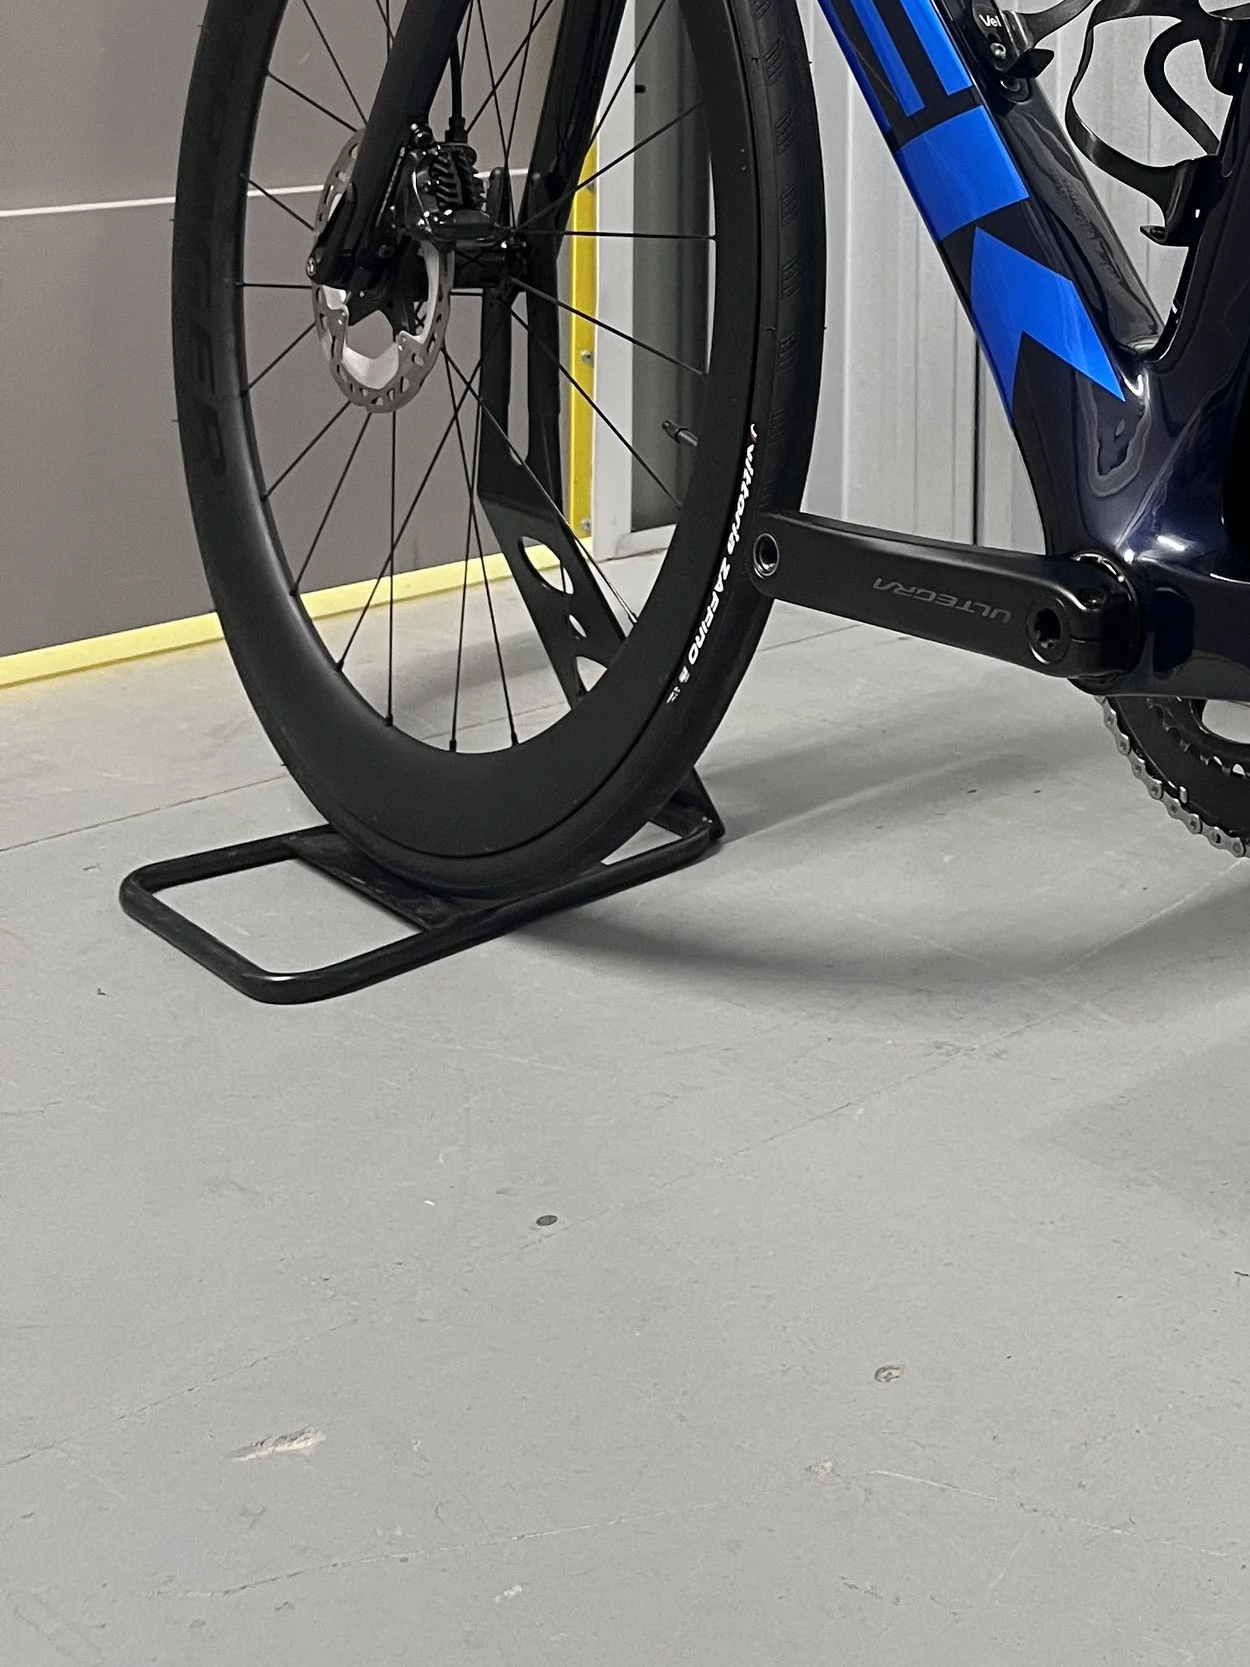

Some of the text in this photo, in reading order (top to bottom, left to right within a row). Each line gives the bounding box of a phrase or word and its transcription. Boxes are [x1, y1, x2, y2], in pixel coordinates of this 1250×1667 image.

[688, 444, 755, 666] vittoria ZAFFIRO
[872, 577, 1012, 623] ULTEGRA
